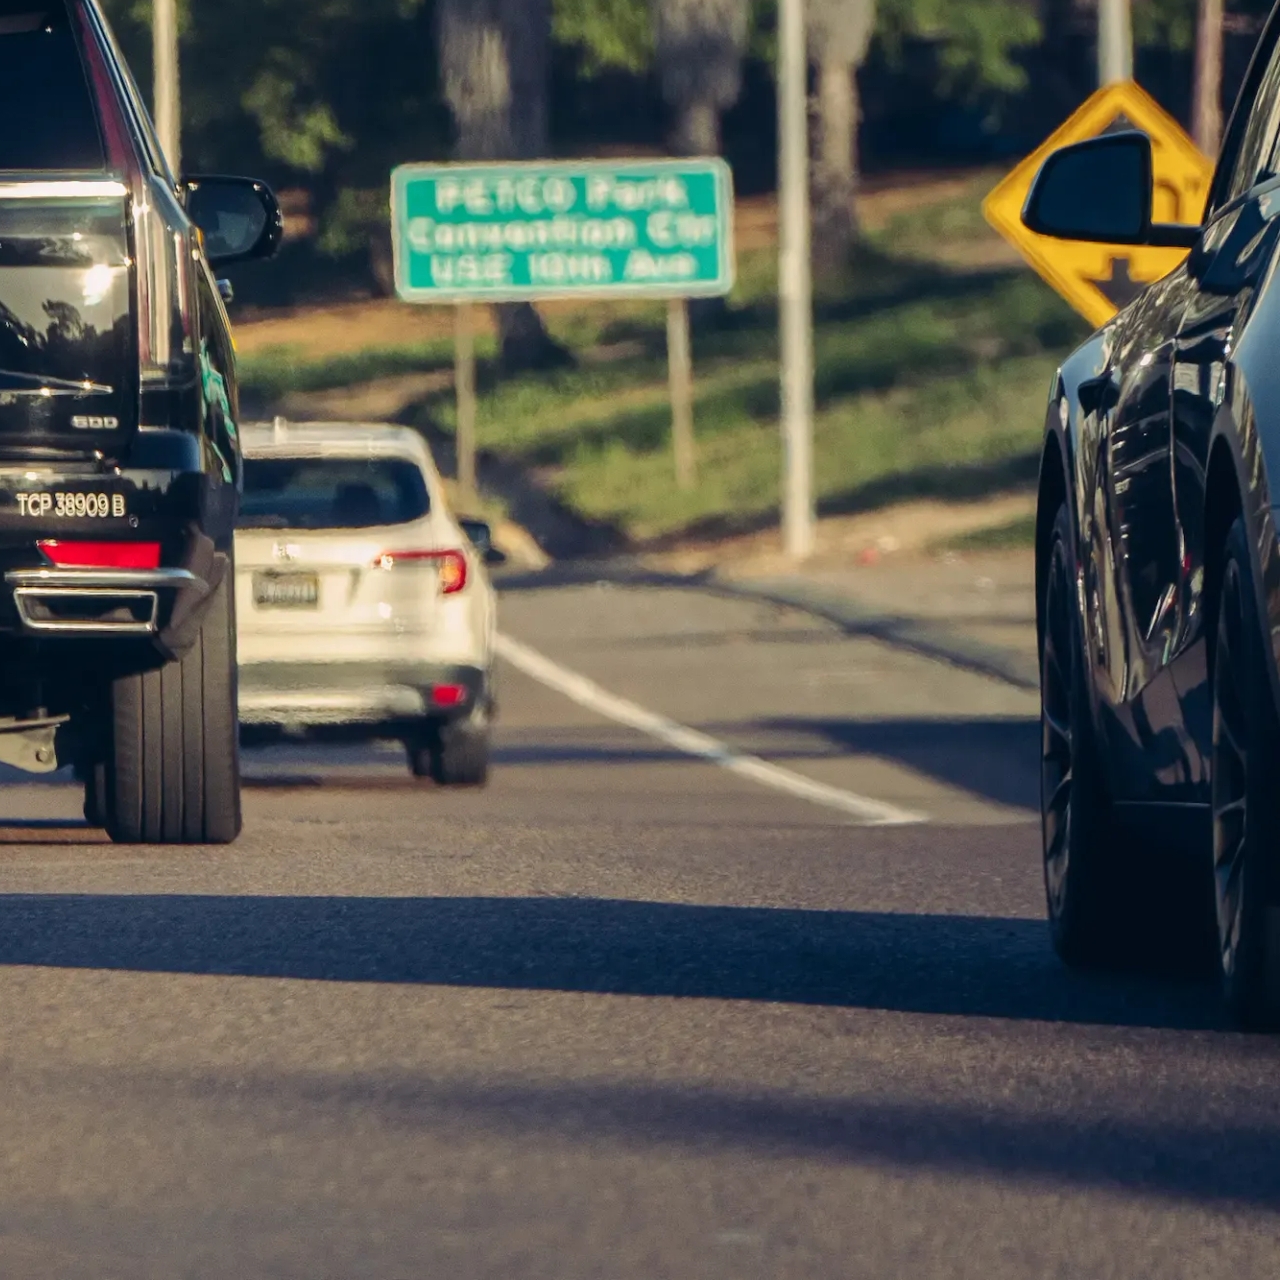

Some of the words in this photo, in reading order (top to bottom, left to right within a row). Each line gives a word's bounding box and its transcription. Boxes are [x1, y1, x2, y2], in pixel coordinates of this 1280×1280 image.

[435, 176, 577, 215] PETCO
[585, 173, 688, 212] Park
[408, 215, 637, 254] Convention
[15, 492, 53, 517] TCP
[54, 492, 110, 518] 38909
[112, 493, 127, 517] B
